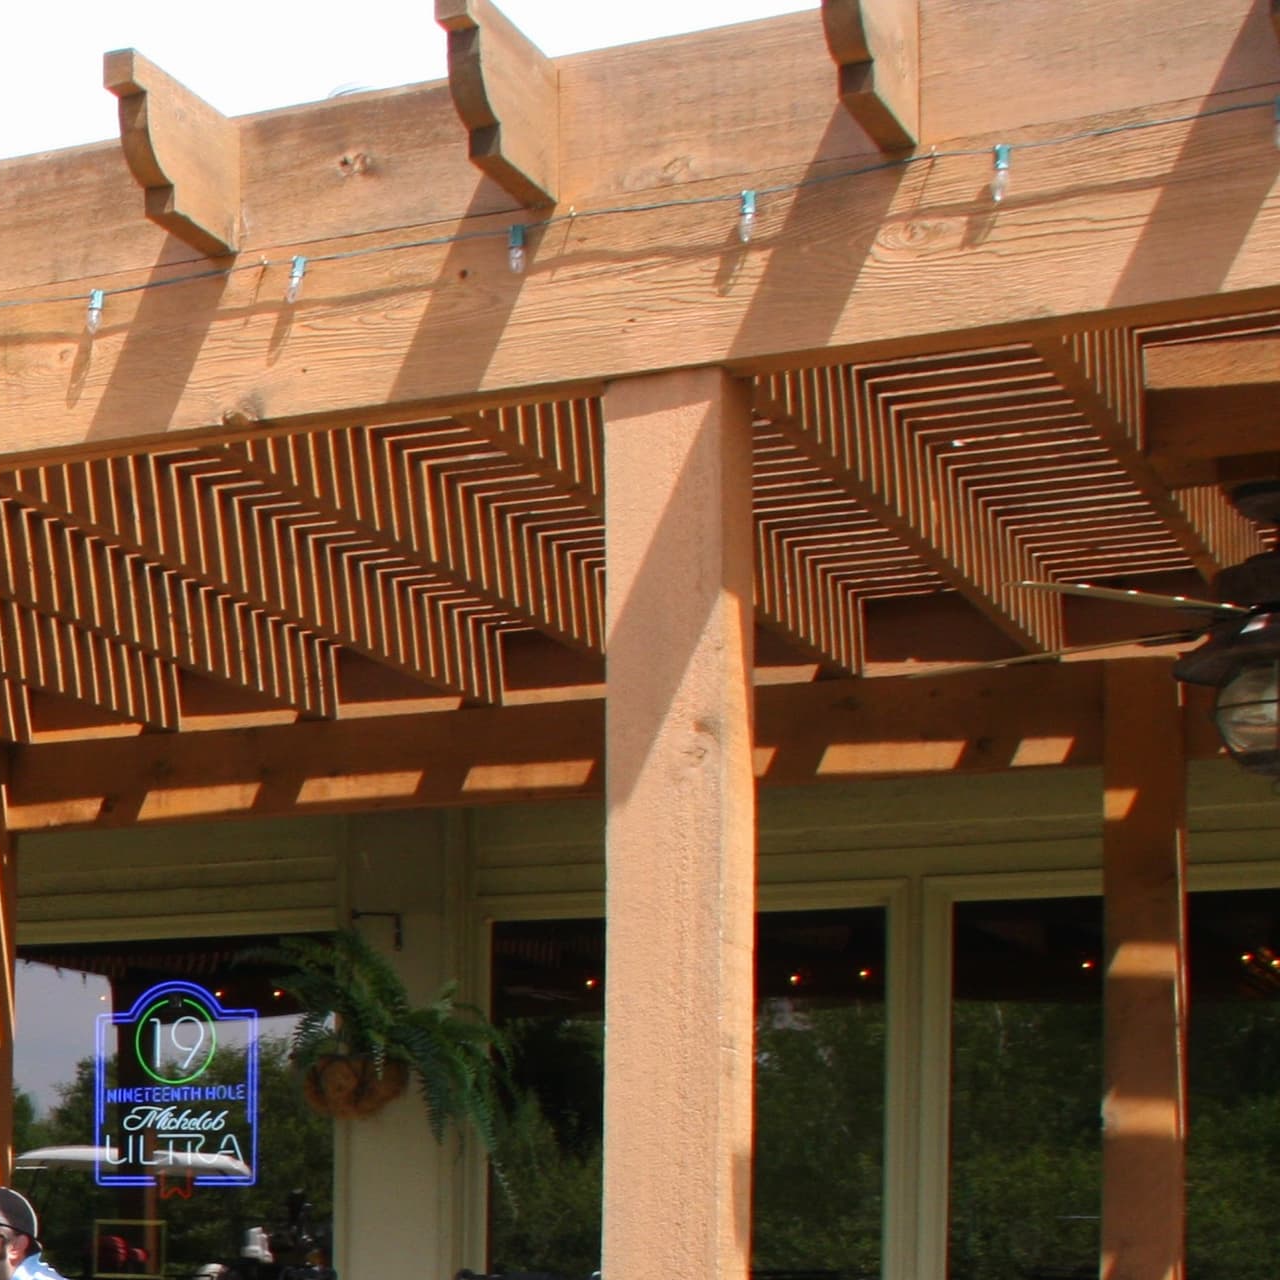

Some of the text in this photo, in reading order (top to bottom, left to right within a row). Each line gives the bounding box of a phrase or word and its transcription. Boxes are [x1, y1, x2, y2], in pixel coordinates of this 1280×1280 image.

[149, 1015, 205, 1069] 19
[107, 1083, 246, 1104] NINETEENTH HOLE
[122, 1105, 229, 1131] Michelob
[105, 1133, 244, 1165] ULTRA
